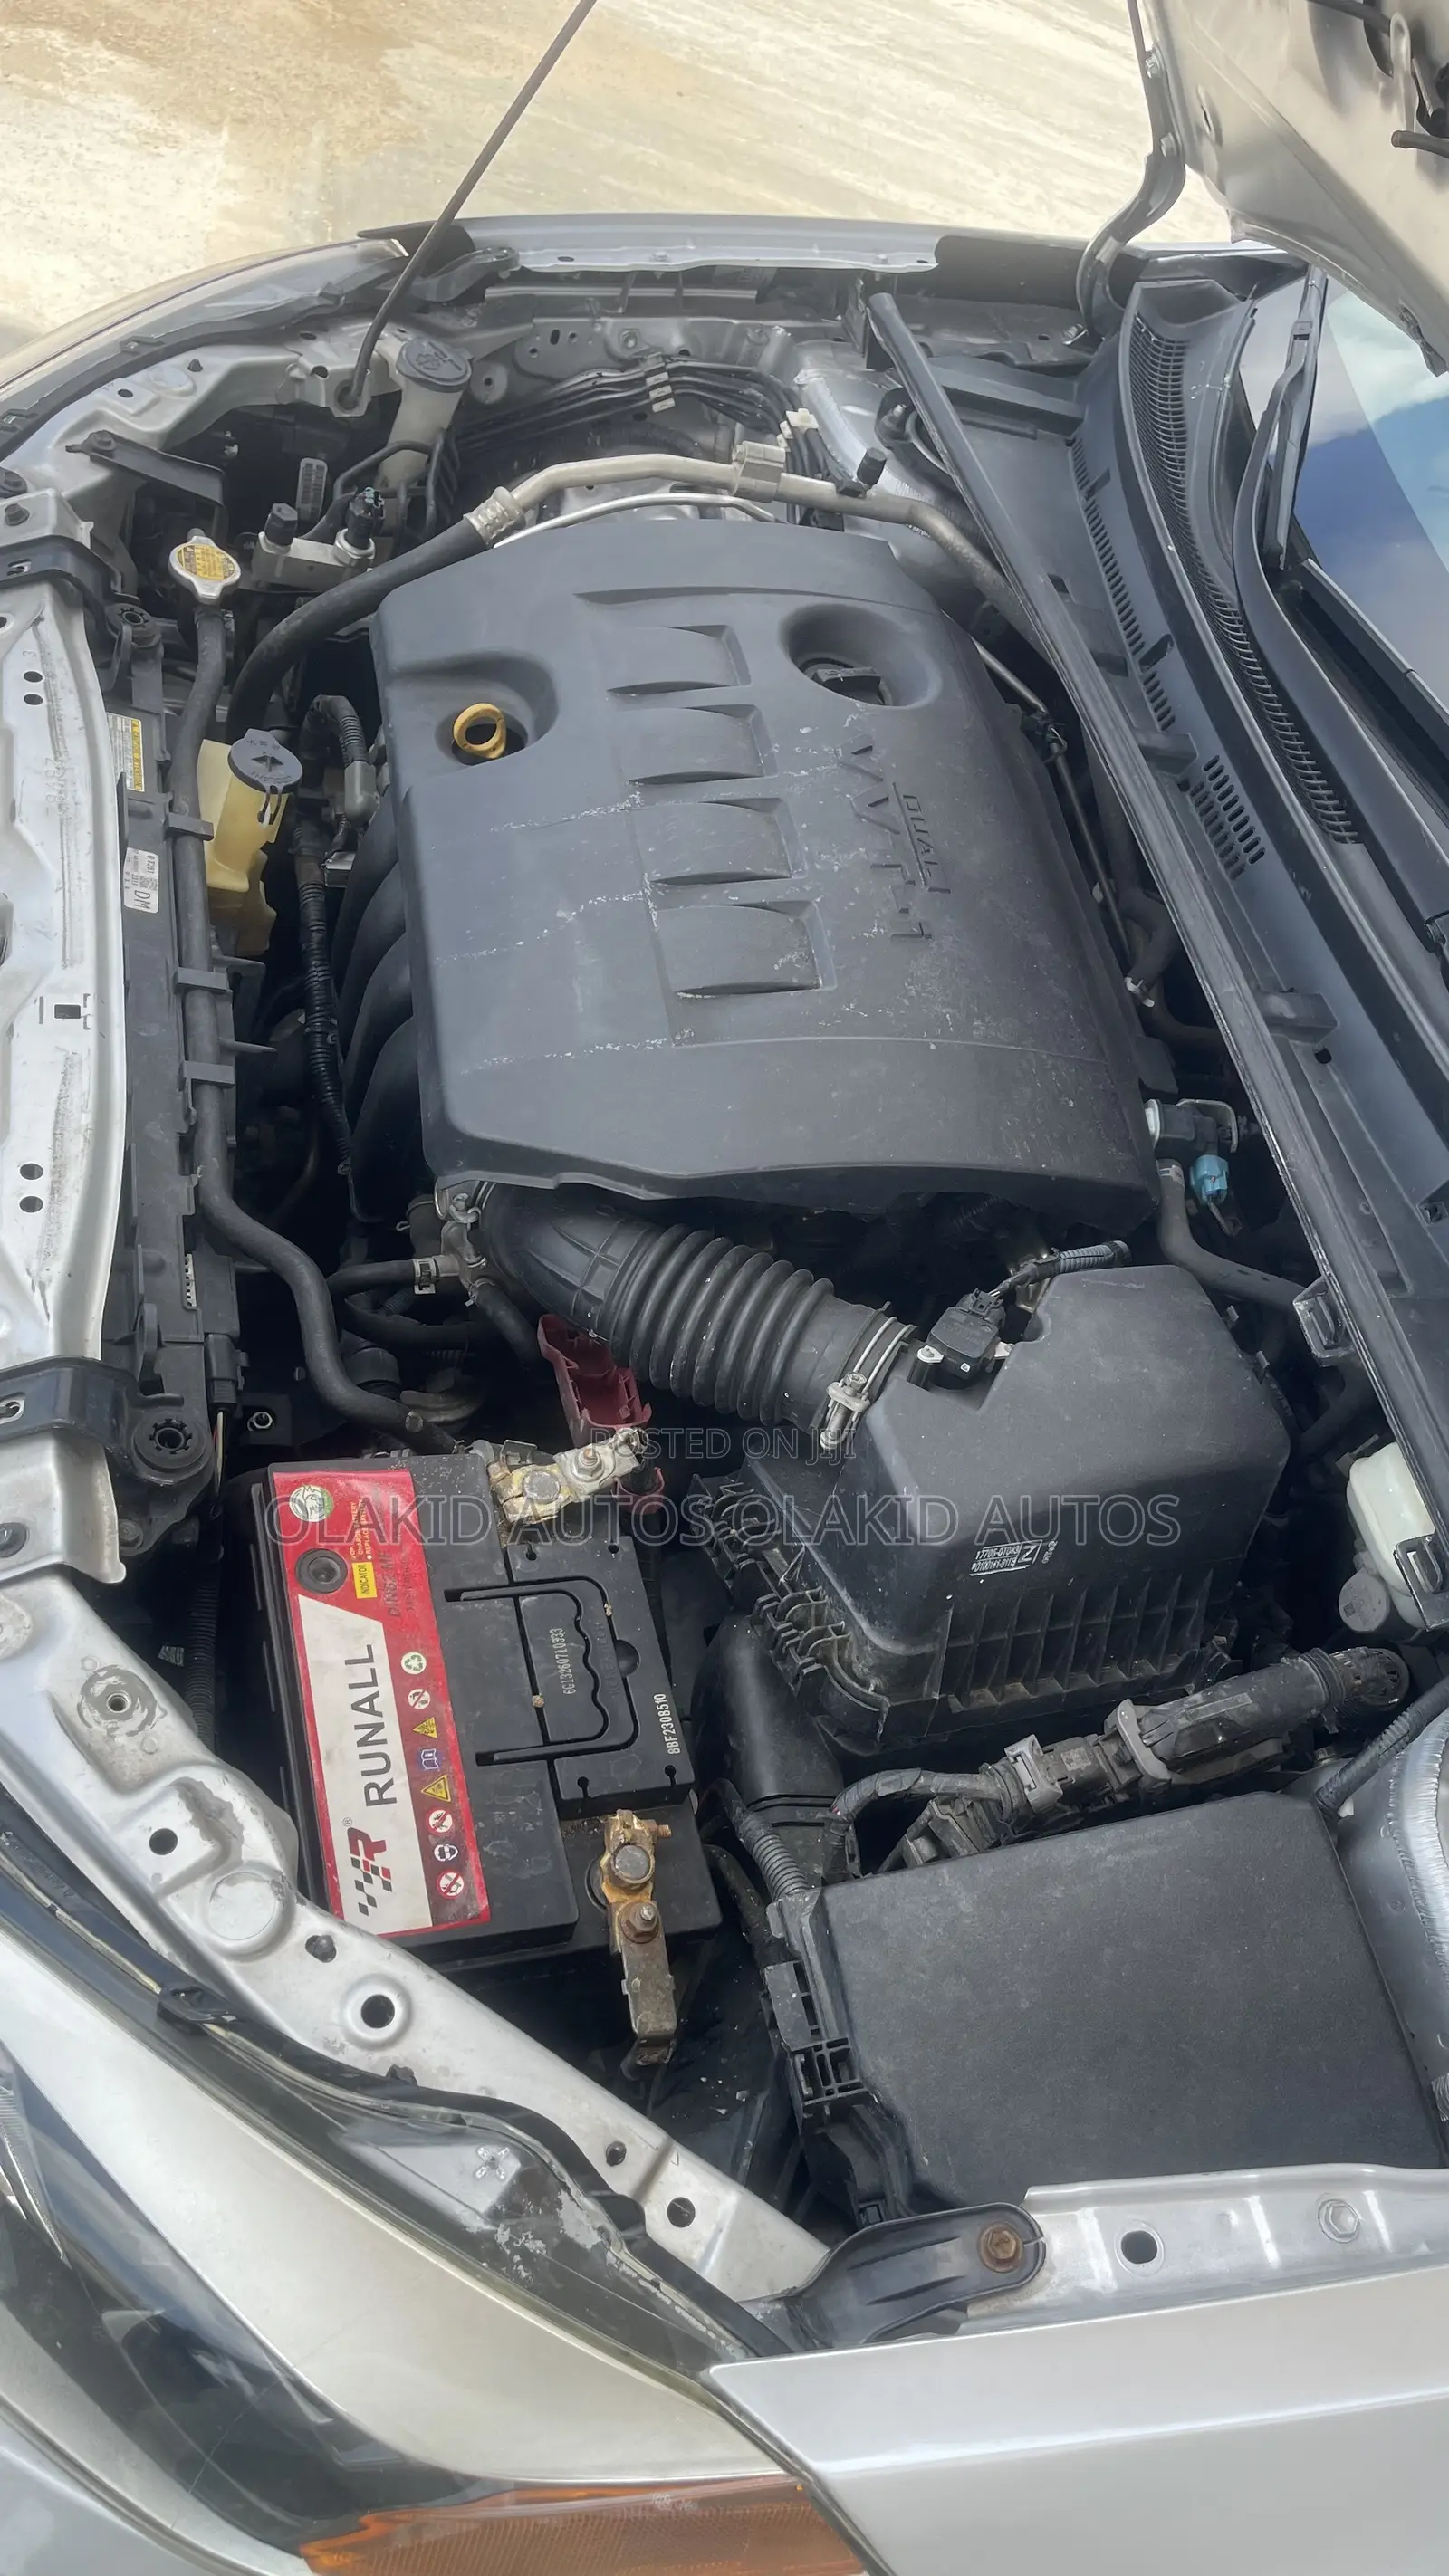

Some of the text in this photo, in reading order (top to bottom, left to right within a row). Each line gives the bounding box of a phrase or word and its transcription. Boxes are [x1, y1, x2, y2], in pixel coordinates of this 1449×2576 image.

[134, 889, 151, 910] DM
[1018, 1545, 1037, 1563] Z
[358, 1564, 369, 1594] INDICATOR
[344, 1644, 398, 1807] RUNALL
[653, 1693, 681, 1755] 8BF2308510
